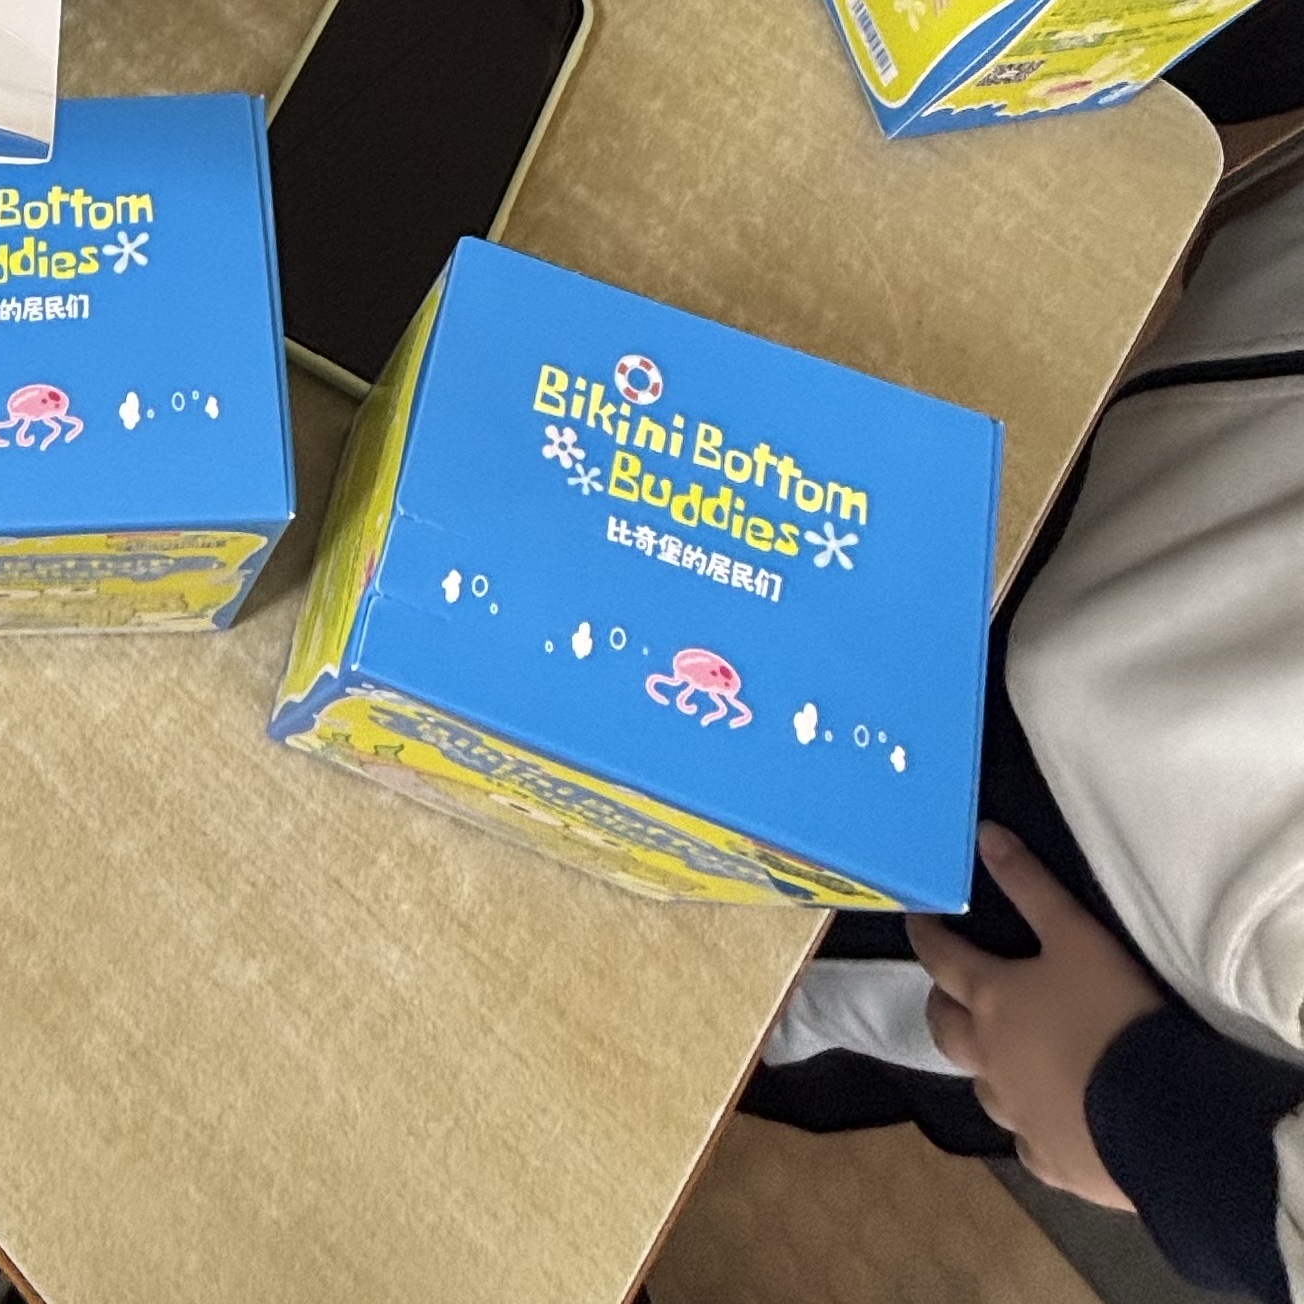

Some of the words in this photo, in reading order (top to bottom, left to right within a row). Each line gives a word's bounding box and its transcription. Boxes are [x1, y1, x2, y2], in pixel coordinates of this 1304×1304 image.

[533, 364, 684, 458] Bikini
[693, 422, 868, 525] Bottom
[608, 450, 800, 557] Buddies
[606, 515, 783, 603] 比奇堡的居民们
